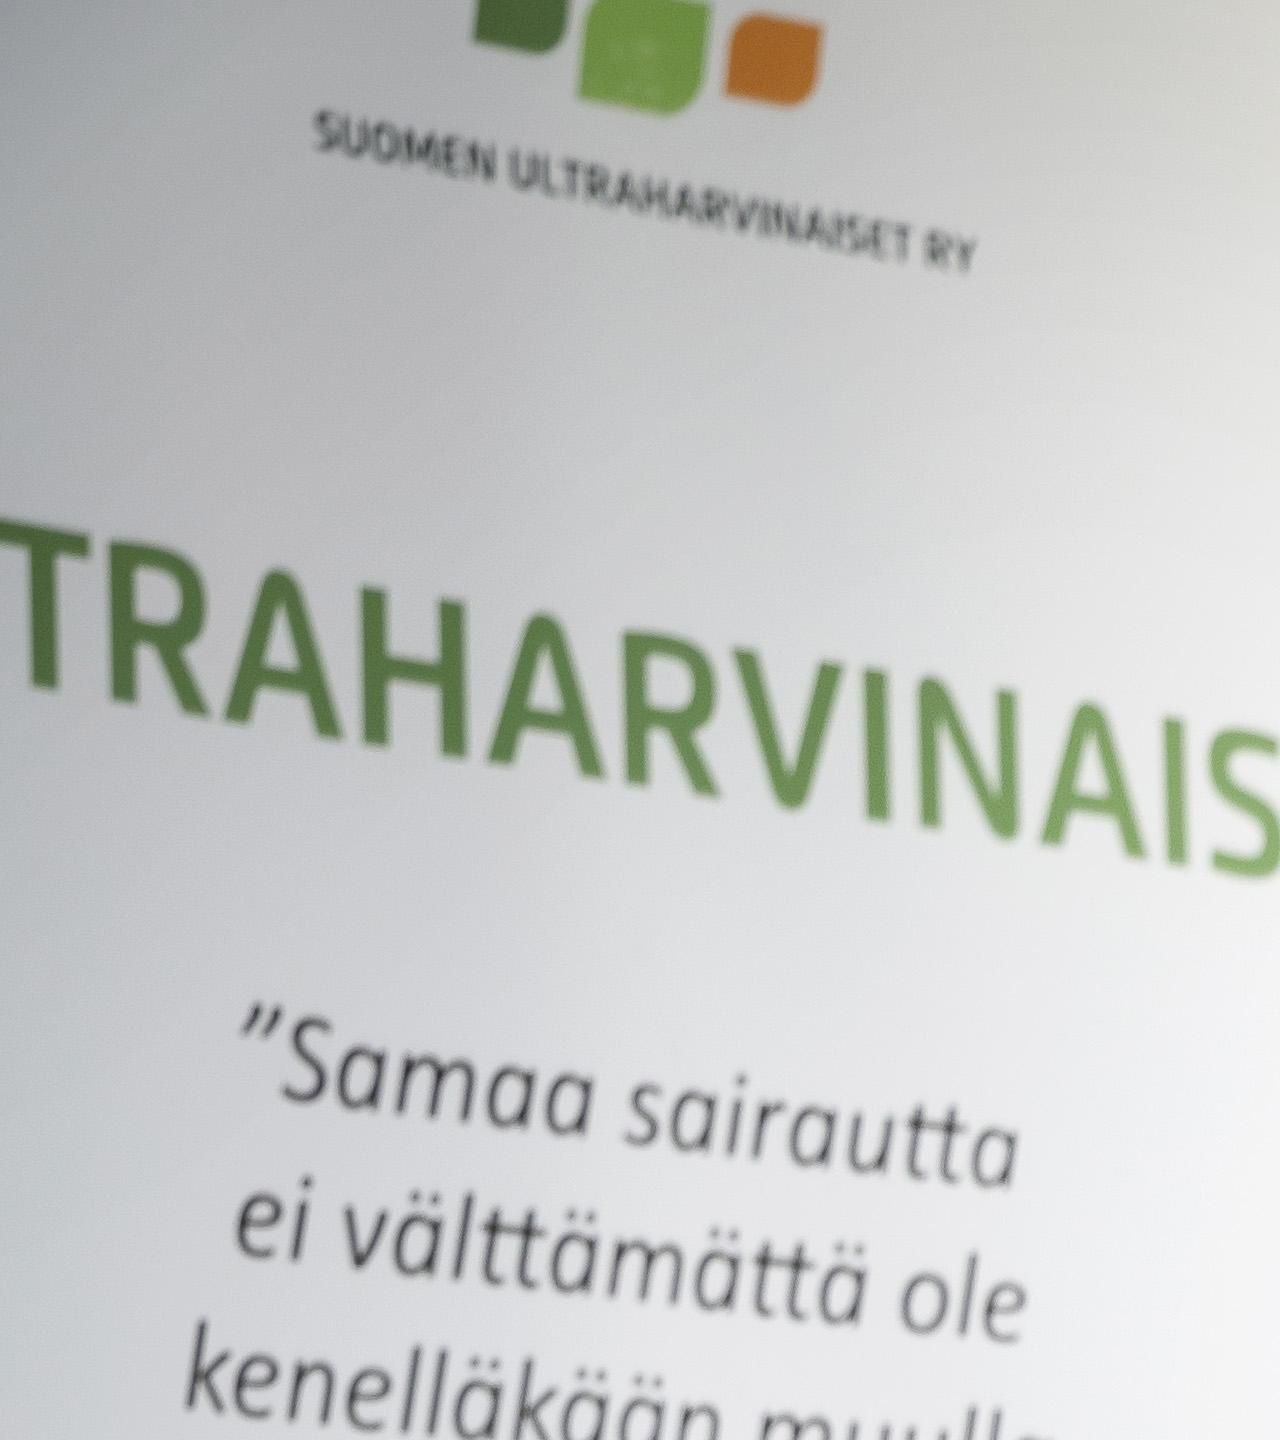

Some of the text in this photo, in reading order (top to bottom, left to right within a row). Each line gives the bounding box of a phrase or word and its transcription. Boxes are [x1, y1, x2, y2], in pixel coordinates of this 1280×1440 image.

[312, 109, 978, 276] SUOMEN ULTRAHARVINAISET RY
[622, 1072, 1020, 1191] sairautta
[233, 1173, 1029, 1345] ei välttämättä ole
